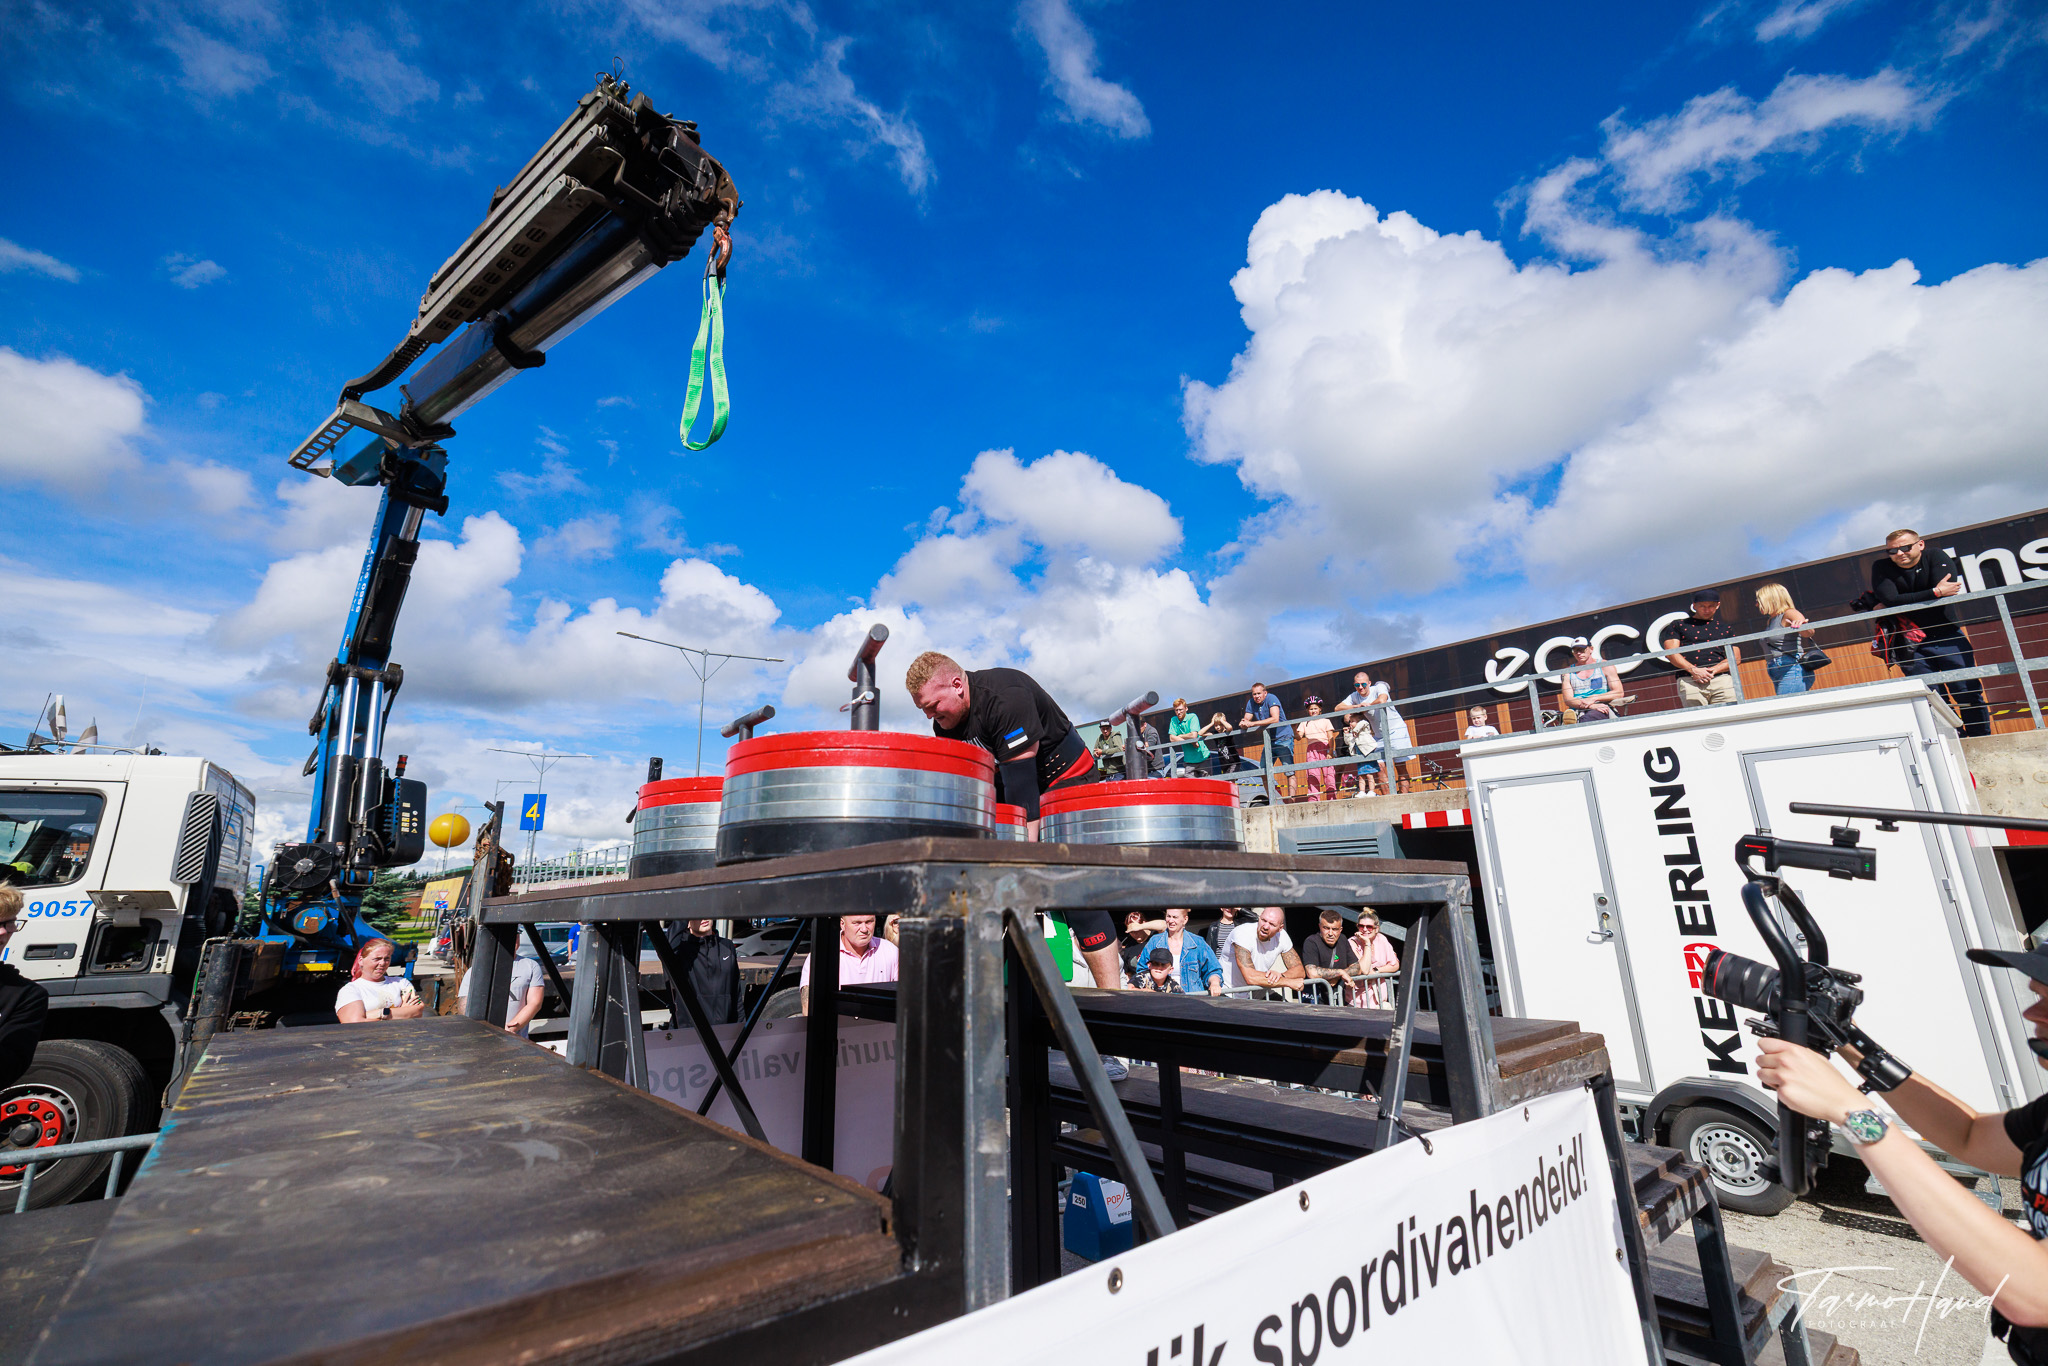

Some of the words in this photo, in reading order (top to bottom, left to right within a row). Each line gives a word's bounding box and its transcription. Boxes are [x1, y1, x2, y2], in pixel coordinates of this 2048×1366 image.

[525, 803, 540, 821] 4
[28, 900, 93, 918] 9057
[1074, 1195, 1086, 1206] 250
[1106, 1194, 1121, 1205] POP
[1253, 1133, 1588, 1366] spordivahendeid!
